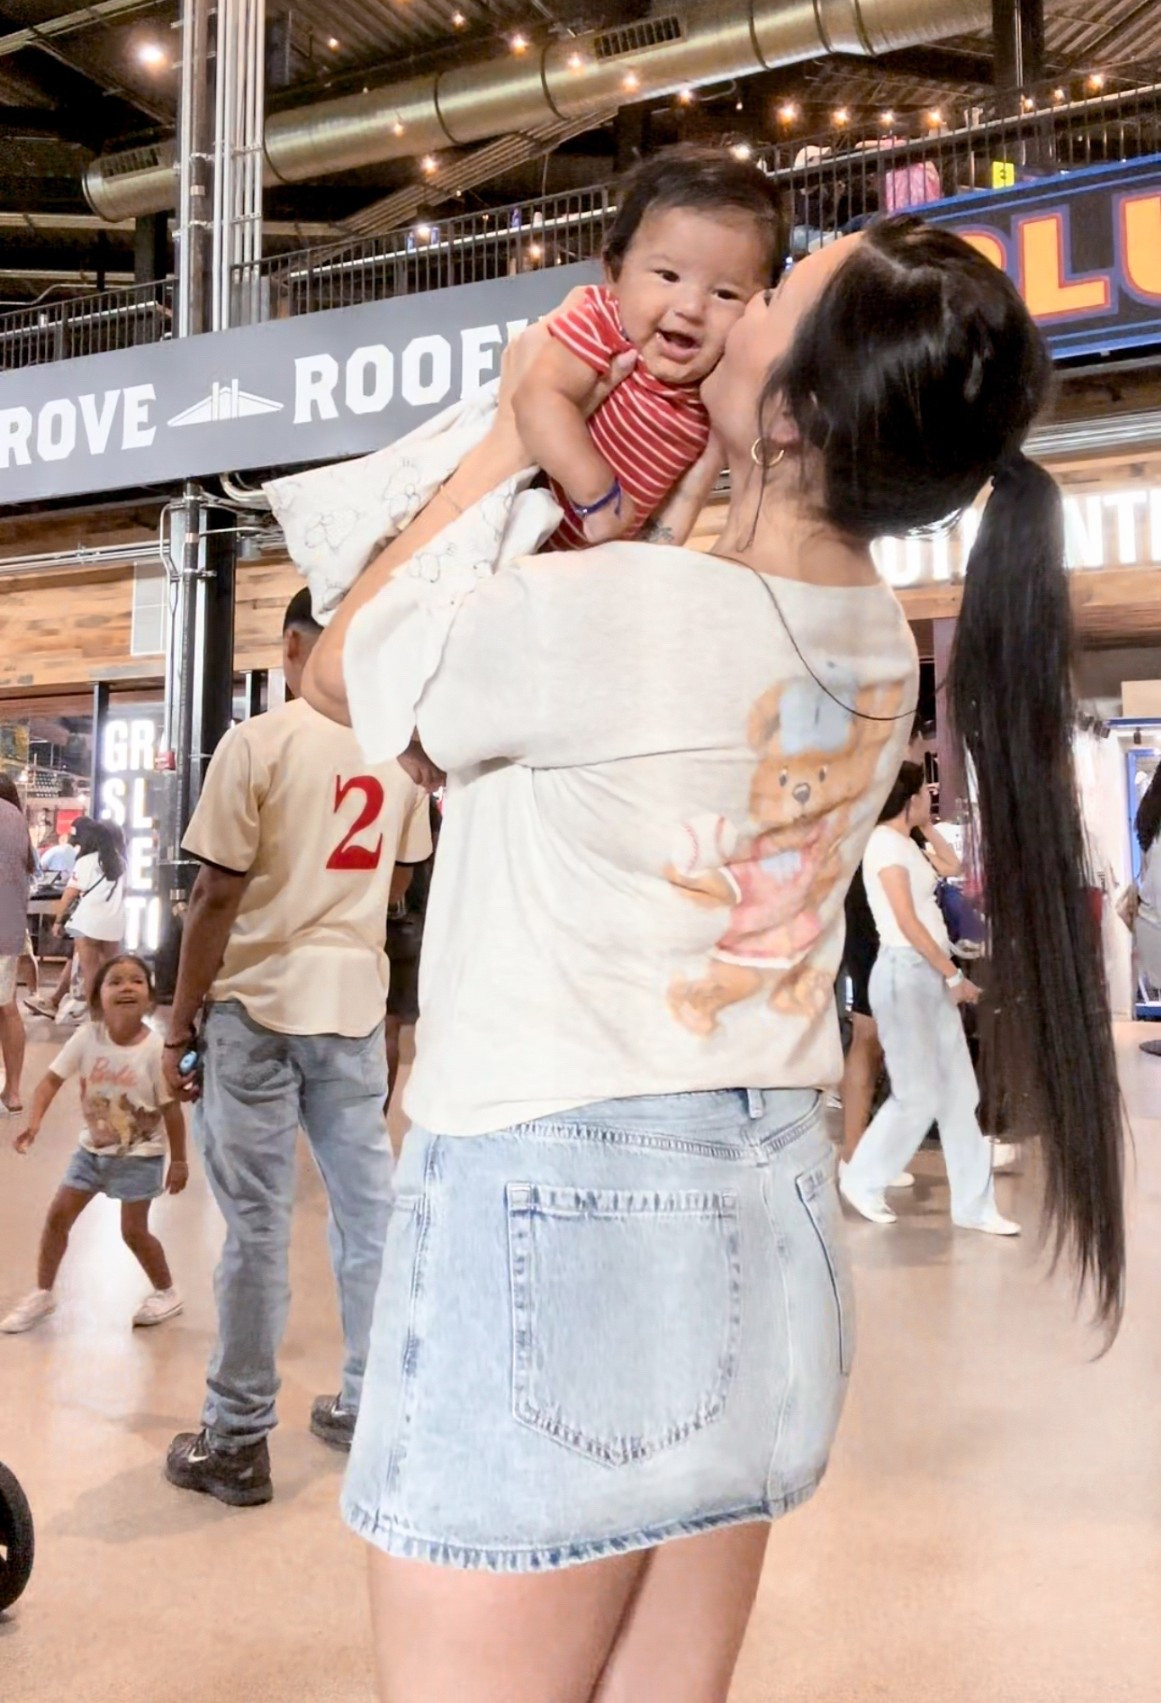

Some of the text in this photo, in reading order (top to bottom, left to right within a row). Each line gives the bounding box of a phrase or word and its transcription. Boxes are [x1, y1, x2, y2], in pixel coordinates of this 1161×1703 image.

[0, 317, 545, 468] ROVE ROOF
[105, 720, 167, 772] GR
[326, 775, 384, 870] 2
